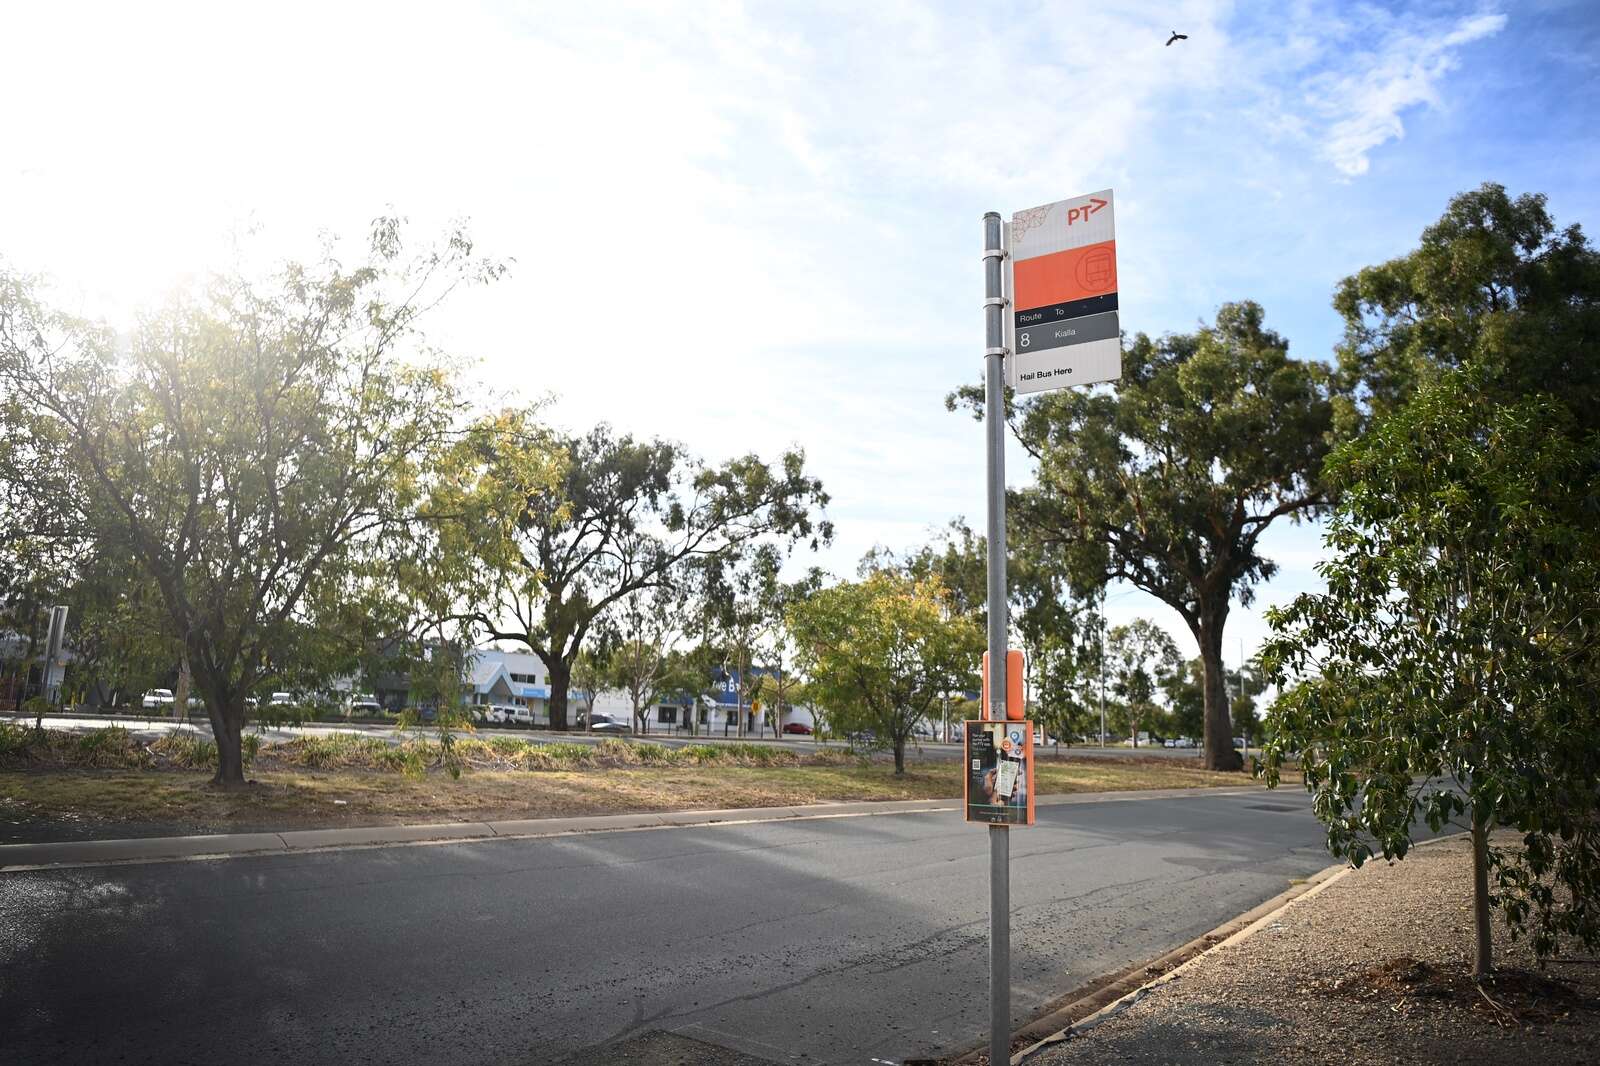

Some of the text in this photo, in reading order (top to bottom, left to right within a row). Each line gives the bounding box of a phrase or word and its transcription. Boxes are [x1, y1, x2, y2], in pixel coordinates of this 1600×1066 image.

[1020, 308, 1065, 323] Route To
[1020, 329, 1076, 347] 8 Kialla
[1020, 368, 1073, 381] Hail Bus Here
